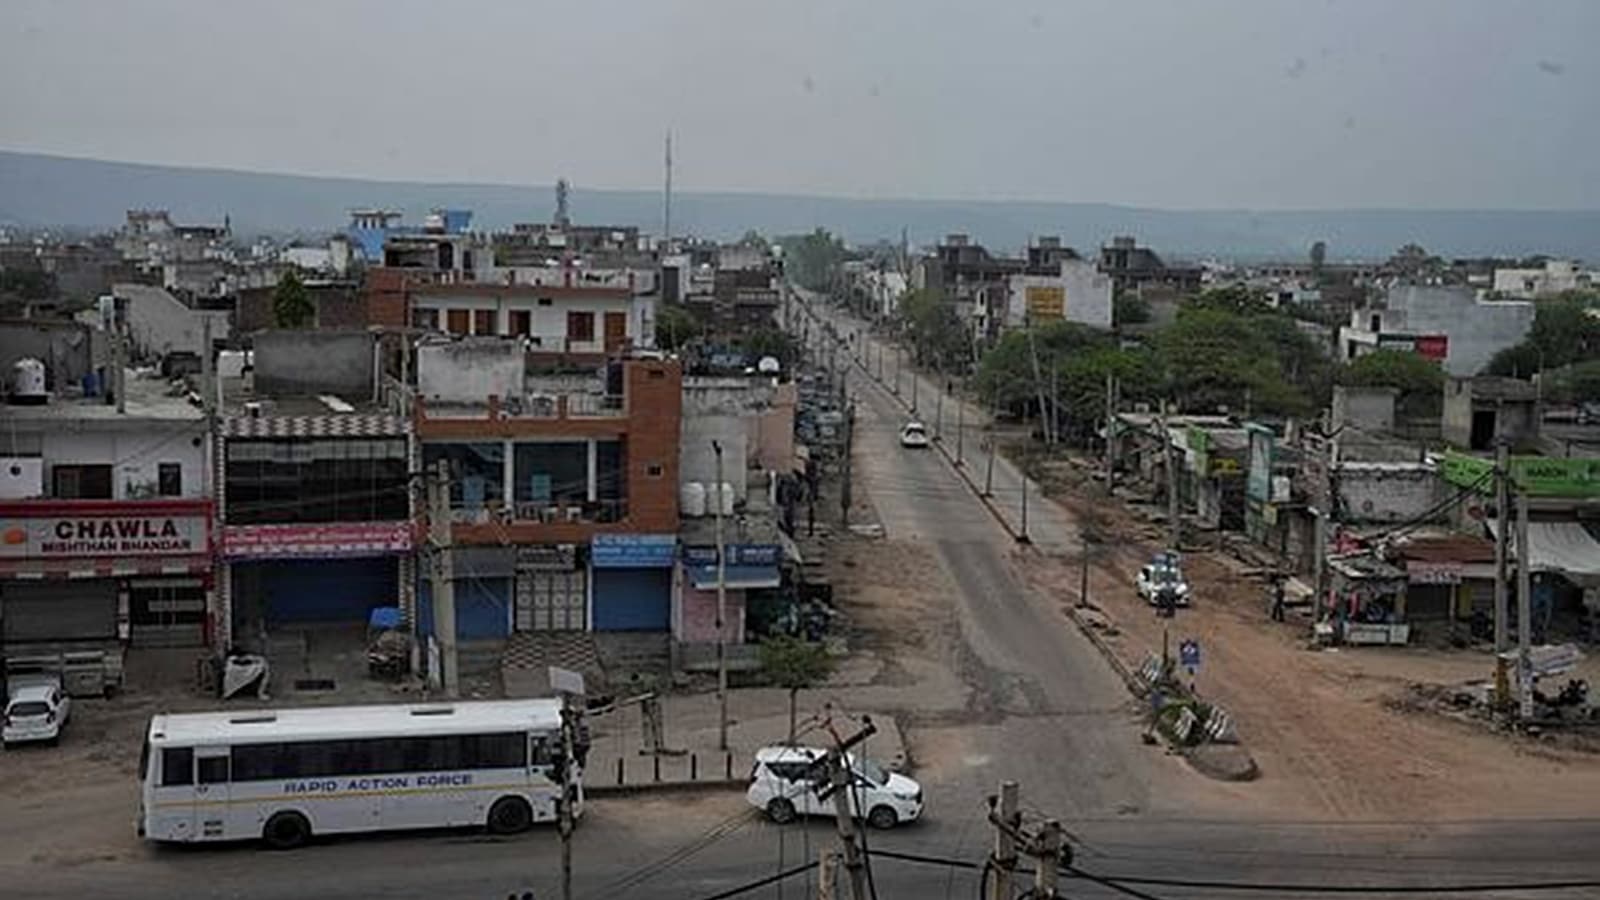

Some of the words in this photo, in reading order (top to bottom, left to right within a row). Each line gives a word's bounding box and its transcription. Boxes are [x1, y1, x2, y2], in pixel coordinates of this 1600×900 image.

[55, 519, 178, 539] CHAWLA
[41, 540, 117, 553] MISHTHAN
[121, 539, 192, 551] BHANDAR
[283, 780, 338, 793] RAPID
[347, 777, 409, 790] ACTION
[416, 773, 473, 787] FORCE
